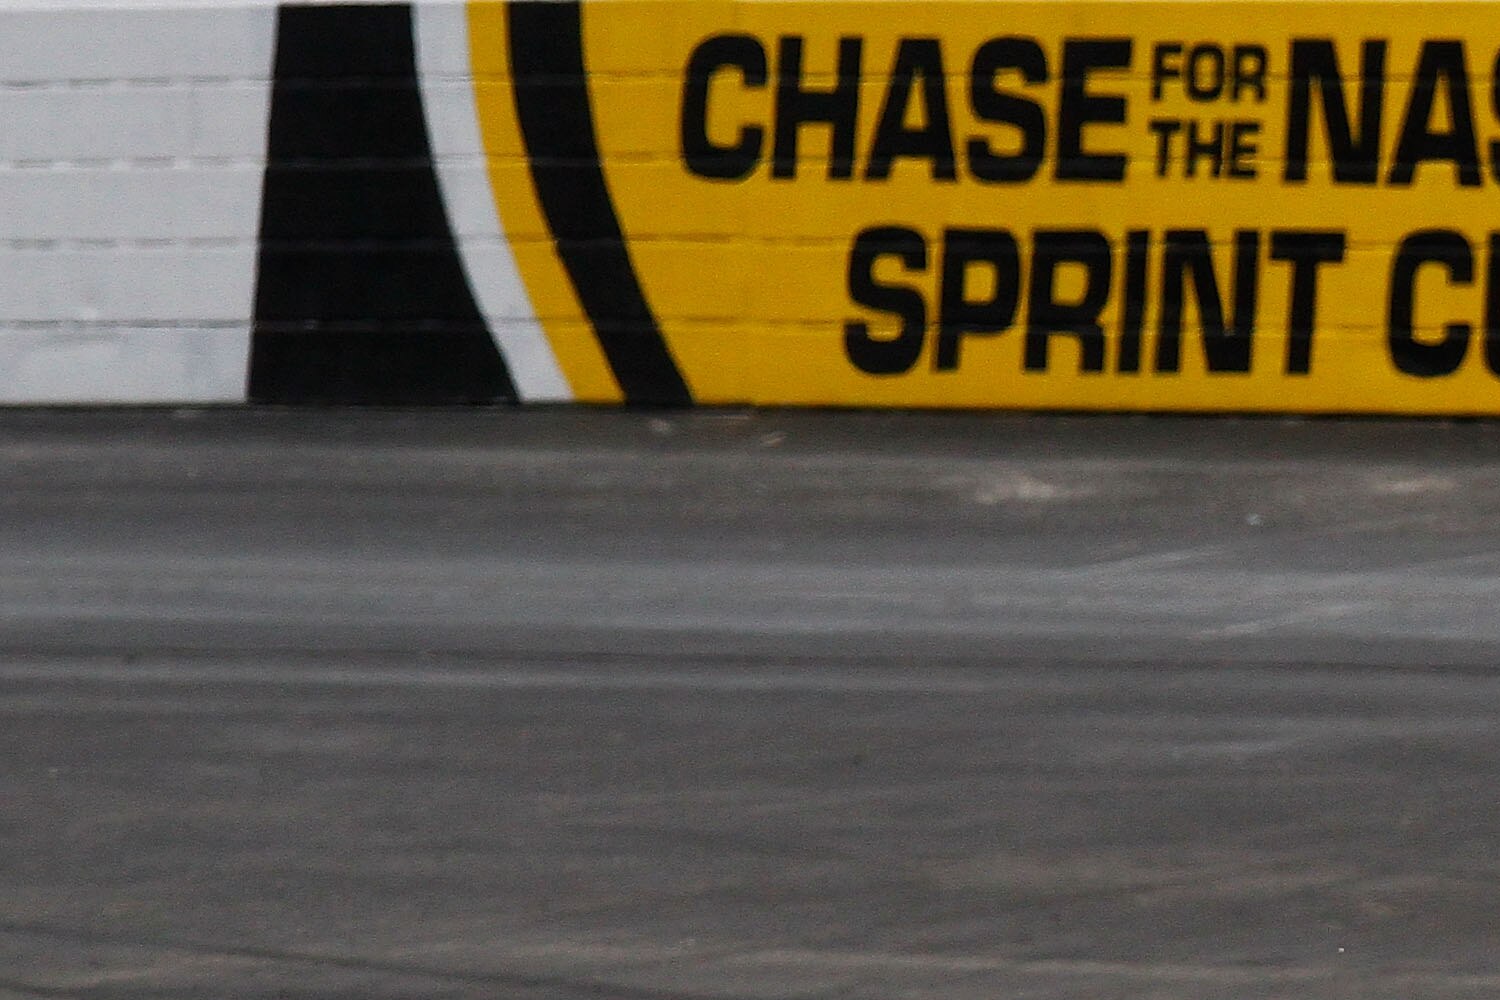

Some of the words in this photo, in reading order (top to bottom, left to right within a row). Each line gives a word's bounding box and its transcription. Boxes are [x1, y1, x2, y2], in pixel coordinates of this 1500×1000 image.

[681, 32, 1133, 186] CHASE
[1149, 41, 1268, 103] FOR
[1148, 118, 1262, 180] THE
[843, 224, 1346, 377] SPRINT
